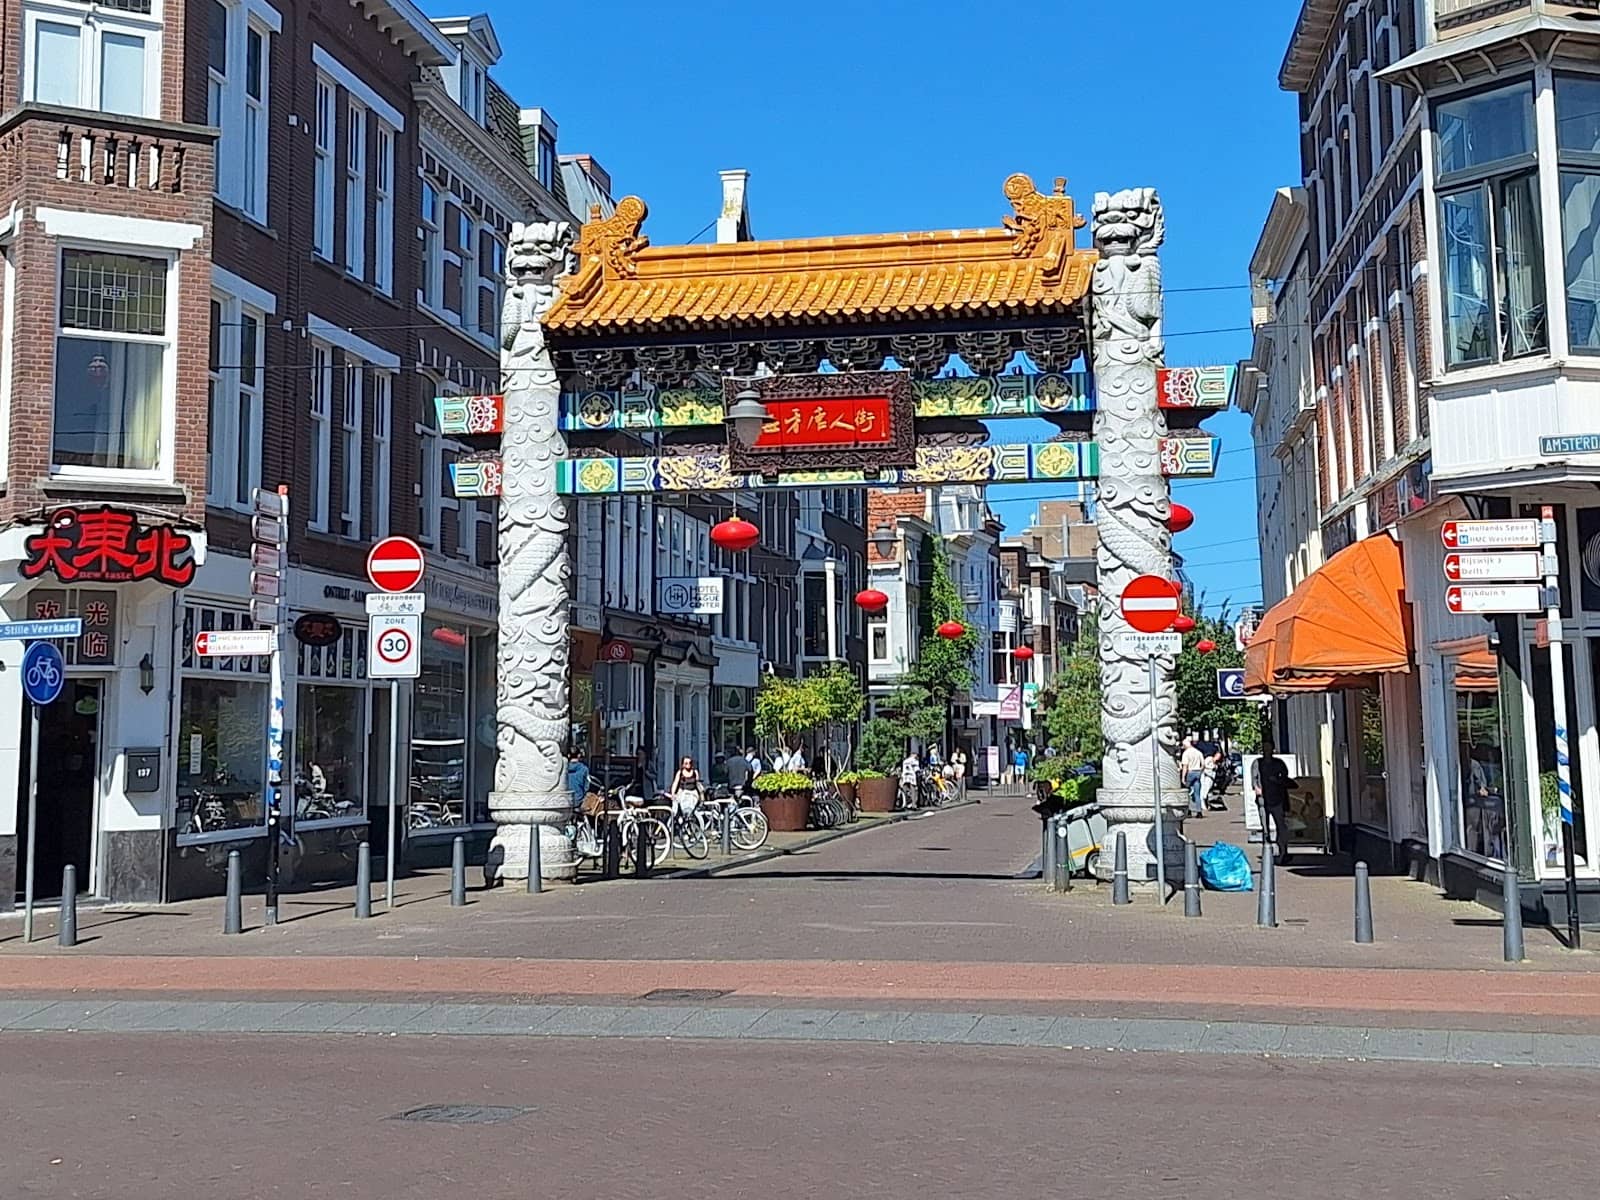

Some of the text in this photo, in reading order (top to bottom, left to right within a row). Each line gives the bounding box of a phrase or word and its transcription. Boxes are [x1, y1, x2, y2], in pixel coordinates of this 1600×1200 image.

[1545, 436, 1600, 452] AMSTERD
[1469, 524, 1503, 532] Hollands
[1505, 523, 1528, 532] Spoor
[25, 509, 193, 584] 大東北
[1461, 556, 1494, 566] Rijswijk
[1461, 567, 1483, 575] Delft
[689, 585, 720, 593] HOTEL
[370, 594, 422, 602] uitgezonderd
[689, 594, 720, 602] HAGUE
[689, 601, 720, 609] CENTER
[384, 617, 406, 625] ZONE
[4, 623, 76, 635] Stille Veerkade
[1124, 634, 1178, 642] uitgezonderd
[383, 638, 407, 652] 30
